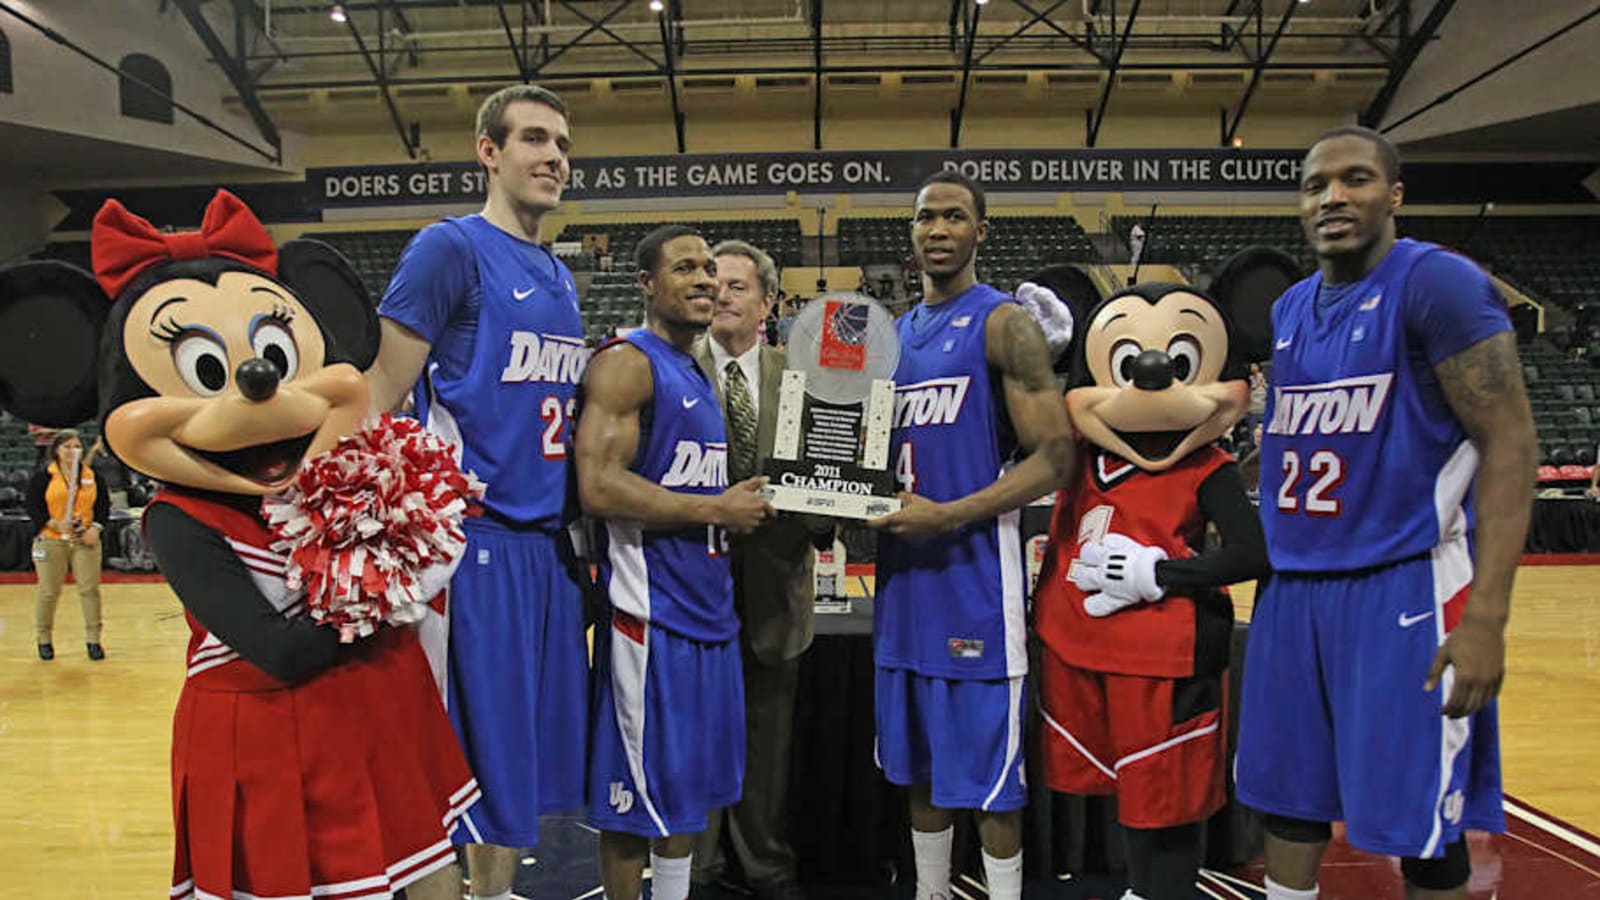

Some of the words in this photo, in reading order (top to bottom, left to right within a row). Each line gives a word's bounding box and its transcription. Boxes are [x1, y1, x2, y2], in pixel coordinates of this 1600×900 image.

[325, 175, 400, 197] DOERS
[408, 173, 453, 194] GET
[595, 167, 626, 188] AS
[635, 165, 677, 187] THE
[687, 163, 758, 186] GAME
[768, 161, 833, 184] GOES
[843, 161, 891, 183] ON.
[943, 159, 1022, 181] DOERS
[1031, 159, 1124, 181] DELIVER
[1133, 159, 1160, 181] IN
[1168, 159, 1211, 181] THE
[1219, 159, 1303, 181] CLUTCH
[501, 330, 596, 385] DAYTO
[893, 376, 970, 429] YTON
[781, 472, 874, 496] CHAMPION
[814, 463, 841, 478] 2011
[1277, 450, 1342, 516] 22
[609, 781, 634, 815] UD
